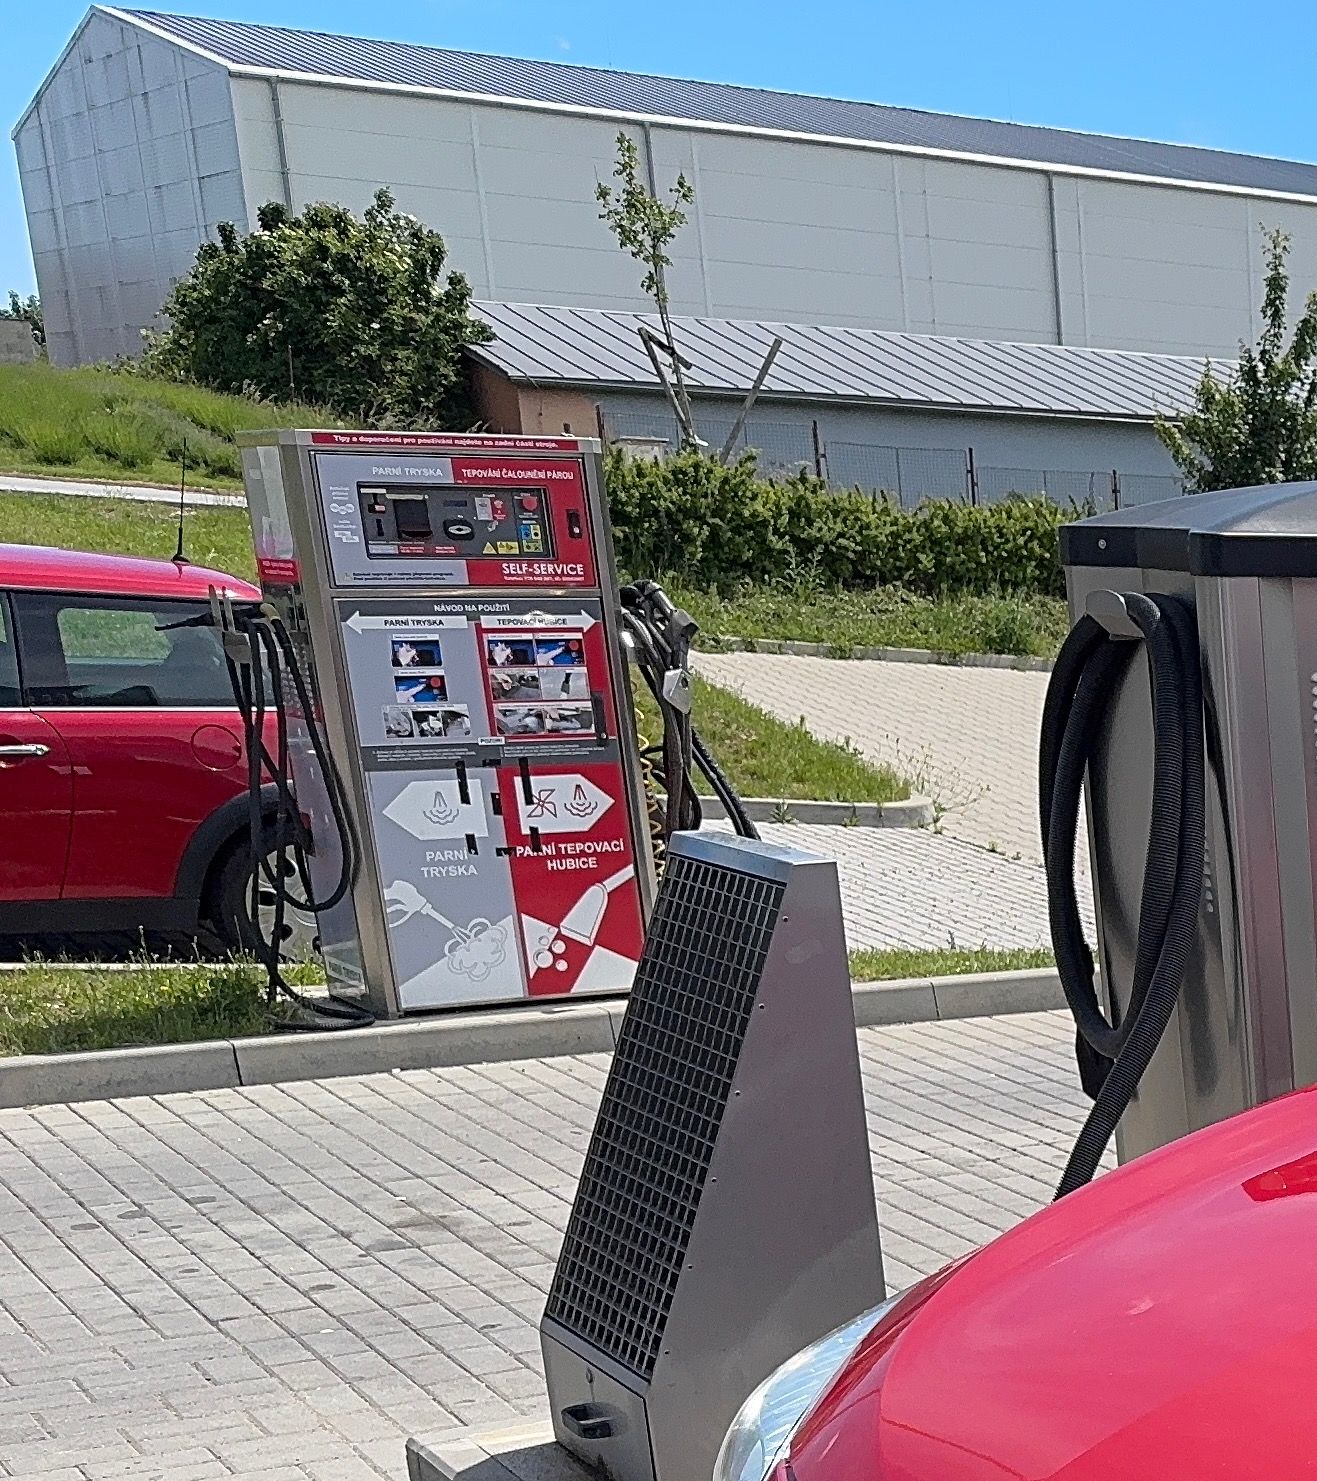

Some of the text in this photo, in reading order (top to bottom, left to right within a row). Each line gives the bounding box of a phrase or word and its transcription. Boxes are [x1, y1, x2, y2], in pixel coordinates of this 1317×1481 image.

[404, 466, 443, 477] TRYSKA
[502, 563, 584, 575] SELF-SERVICE
[434, 602, 463, 612] NÁVOD
[465, 604, 478, 612] NA
[411, 618, 445, 627] TRYSKA
[515, 837, 624, 858] PANÍ TEPOVACÍ
[425, 847, 468, 862] PARNÍ
[546, 857, 598, 870] HUBICE
[420, 865, 478, 878] TRYSKA
